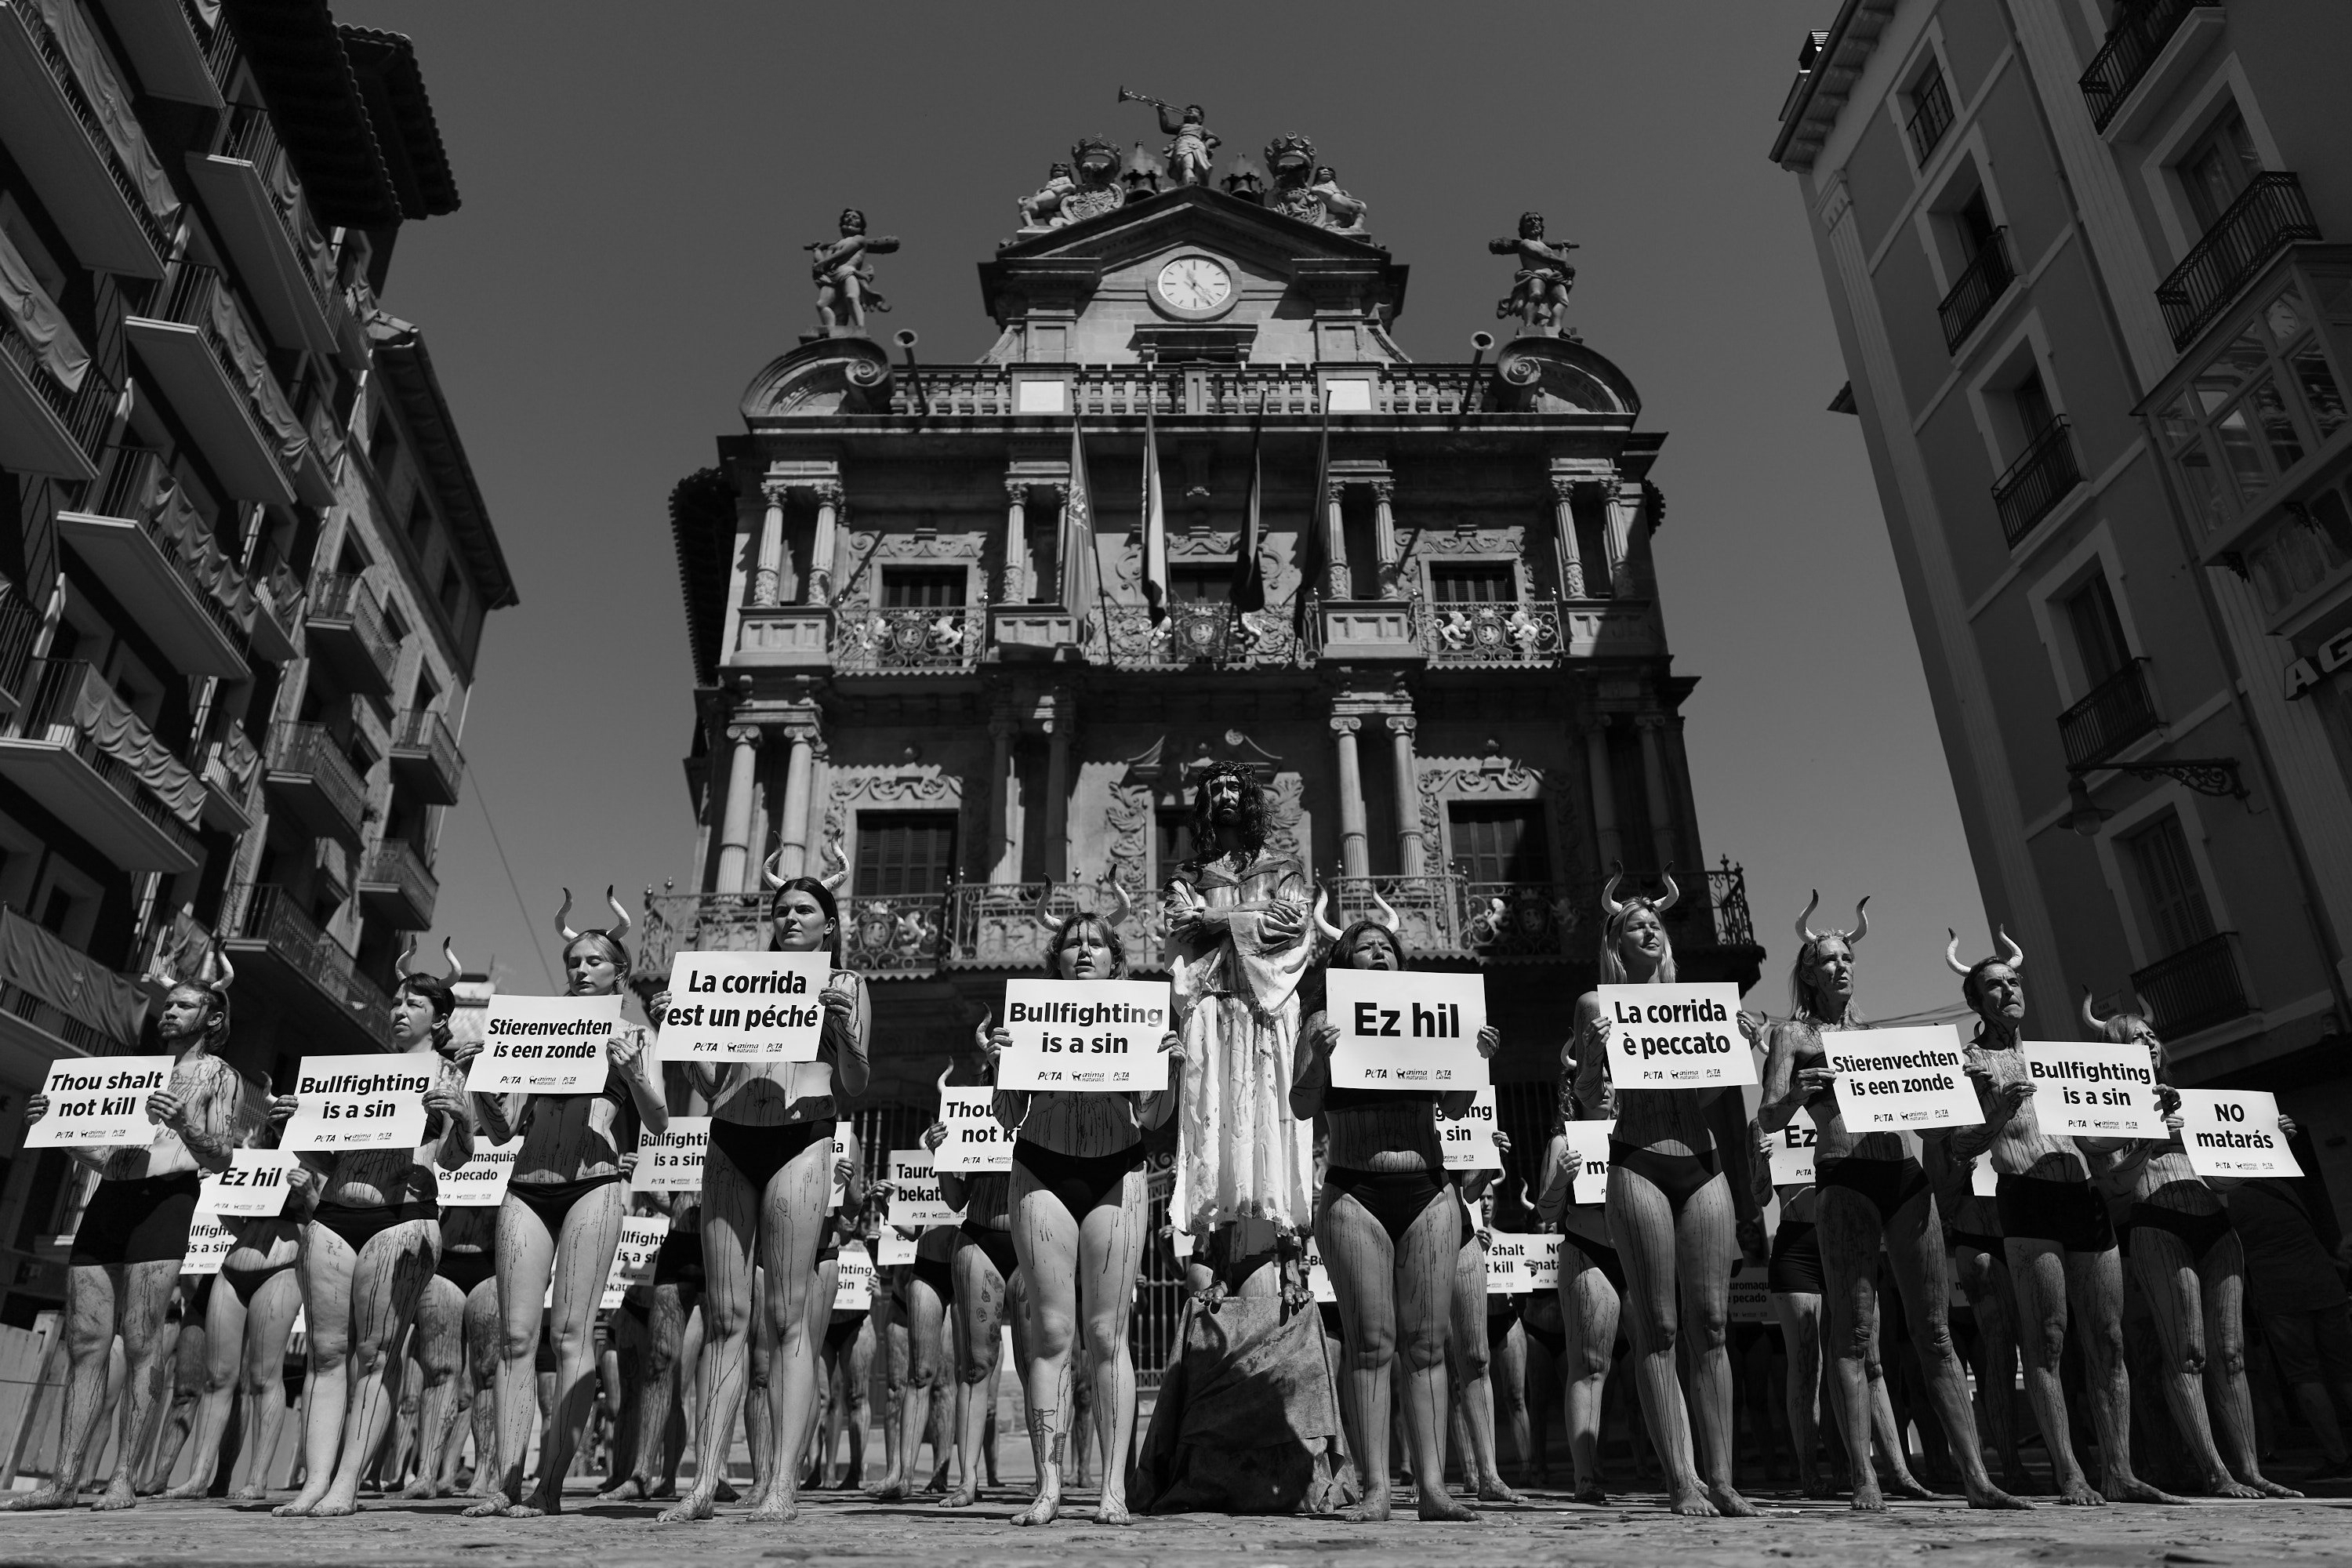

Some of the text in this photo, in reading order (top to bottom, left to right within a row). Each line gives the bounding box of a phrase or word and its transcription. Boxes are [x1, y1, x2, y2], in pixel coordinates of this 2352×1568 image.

[688, 970, 807, 994] La corrida
[667, 1004, 818, 1032] est un péché
[1009, 1002, 1163, 1027] Bullfighting
[1354, 1001, 1460, 1038] Ez hil
[1614, 998, 1727, 1024] La corrida
[488, 1018, 612, 1036] Stierenvechten
[493, 1041, 597, 1058] is een zonde
[1041, 1032, 1128, 1054] is a sin
[1623, 1032, 1731, 1059] è peccato
[1832, 1051, 1959, 1073] Stierenvechten
[50, 1071, 164, 1091] Thou shalt
[2030, 1062, 2151, 1084] Bullfighting
[299, 1073, 430, 1095] Bullfighting
[1849, 1073, 1955, 1096] is een zonde
[2062, 1087, 2132, 1105] is a sin
[58, 1097, 136, 1117] not kill
[322, 1100, 396, 1119] is a sin
[2214, 1103, 2245, 1122] NO
[961, 1126, 997, 1142] not
[1446, 1125, 1472, 1141] sin
[1784, 1125, 1817, 1148] Ez
[2196, 1130, 2274, 1149] matarás
[472, 1151, 517, 1164] maquia
[654, 1152, 706, 1166] is a sin
[219, 1167, 282, 1187] Ez hil
[439, 1169, 498, 1182] es pecado
[187, 1242, 198, 1253] is
[201, 1244, 209, 1253] a
[617, 1248, 629, 1261] is
[632, 1253, 641, 1262] a
[1492, 1243, 1525, 1256] shalt
[1494, 1261, 1514, 1273] kill
[838, 1279, 855, 1290] sin
[1733, 1293, 1767, 1305] pecado
